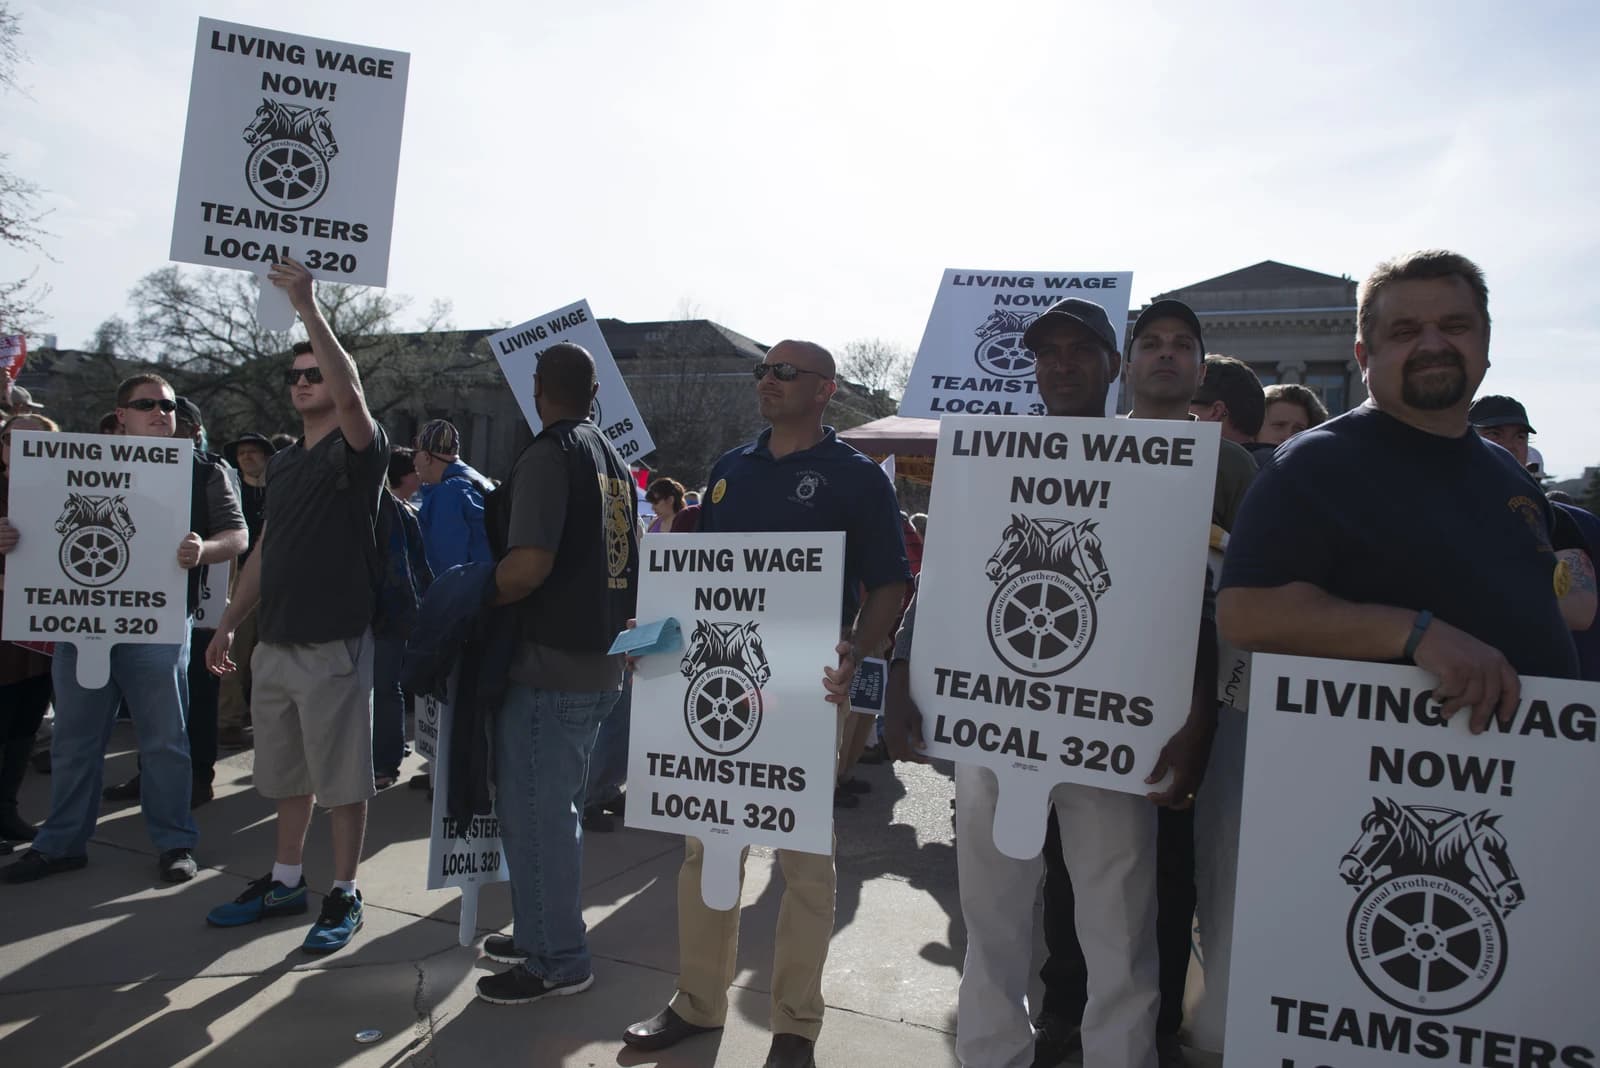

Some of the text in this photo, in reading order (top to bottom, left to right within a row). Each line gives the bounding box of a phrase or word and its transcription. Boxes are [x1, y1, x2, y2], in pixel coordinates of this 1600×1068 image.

[211, 30, 394, 79] LIVING WAGE
[261, 72, 337, 102] NOW!
[201, 201, 368, 243] TEAMSTERS
[305, 249, 357, 273] 320
[952, 275, 1118, 289] LIVING WAGE
[499, 325, 548, 355] LIVING
[547, 308, 588, 334] WAGE
[930, 375, 1039, 395] TEAMST
[930, 397, 1022, 416] LOCAL
[23, 440, 179, 464] LIVING WAGE
[951, 429, 1196, 467] LIVING WAGE
[67, 470, 131, 489] NOW!
[1009, 476, 1111, 509] NOW!
[649, 549, 734, 573] LIVING
[743, 547, 823, 573] WAGE
[24, 588, 166, 608] TEAMSTERS
[694, 587, 766, 612] NOW!
[994, 572, 1088, 649] International Brotherhood of Teamsters
[29, 615, 158, 634] LOCAL 320
[689, 668, 757, 730] International Brotherhood of Teamsters
[933, 667, 1154, 727] TEAMSTERS
[1275, 676, 1448, 727] LIVING
[933, 714, 1135, 775] LOCAL 320
[646, 752, 806, 792] TEAMSTERS
[1369, 745, 1515, 797] NOW!
[442, 817, 502, 839] TEASTER
[651, 792, 796, 833] LOCAL 320
[442, 852, 500, 876] LOCAL 320
[1358, 877, 1494, 980] International Brotherhood of Teamsters
[1270, 996, 1596, 1068] TEAMSTERS
